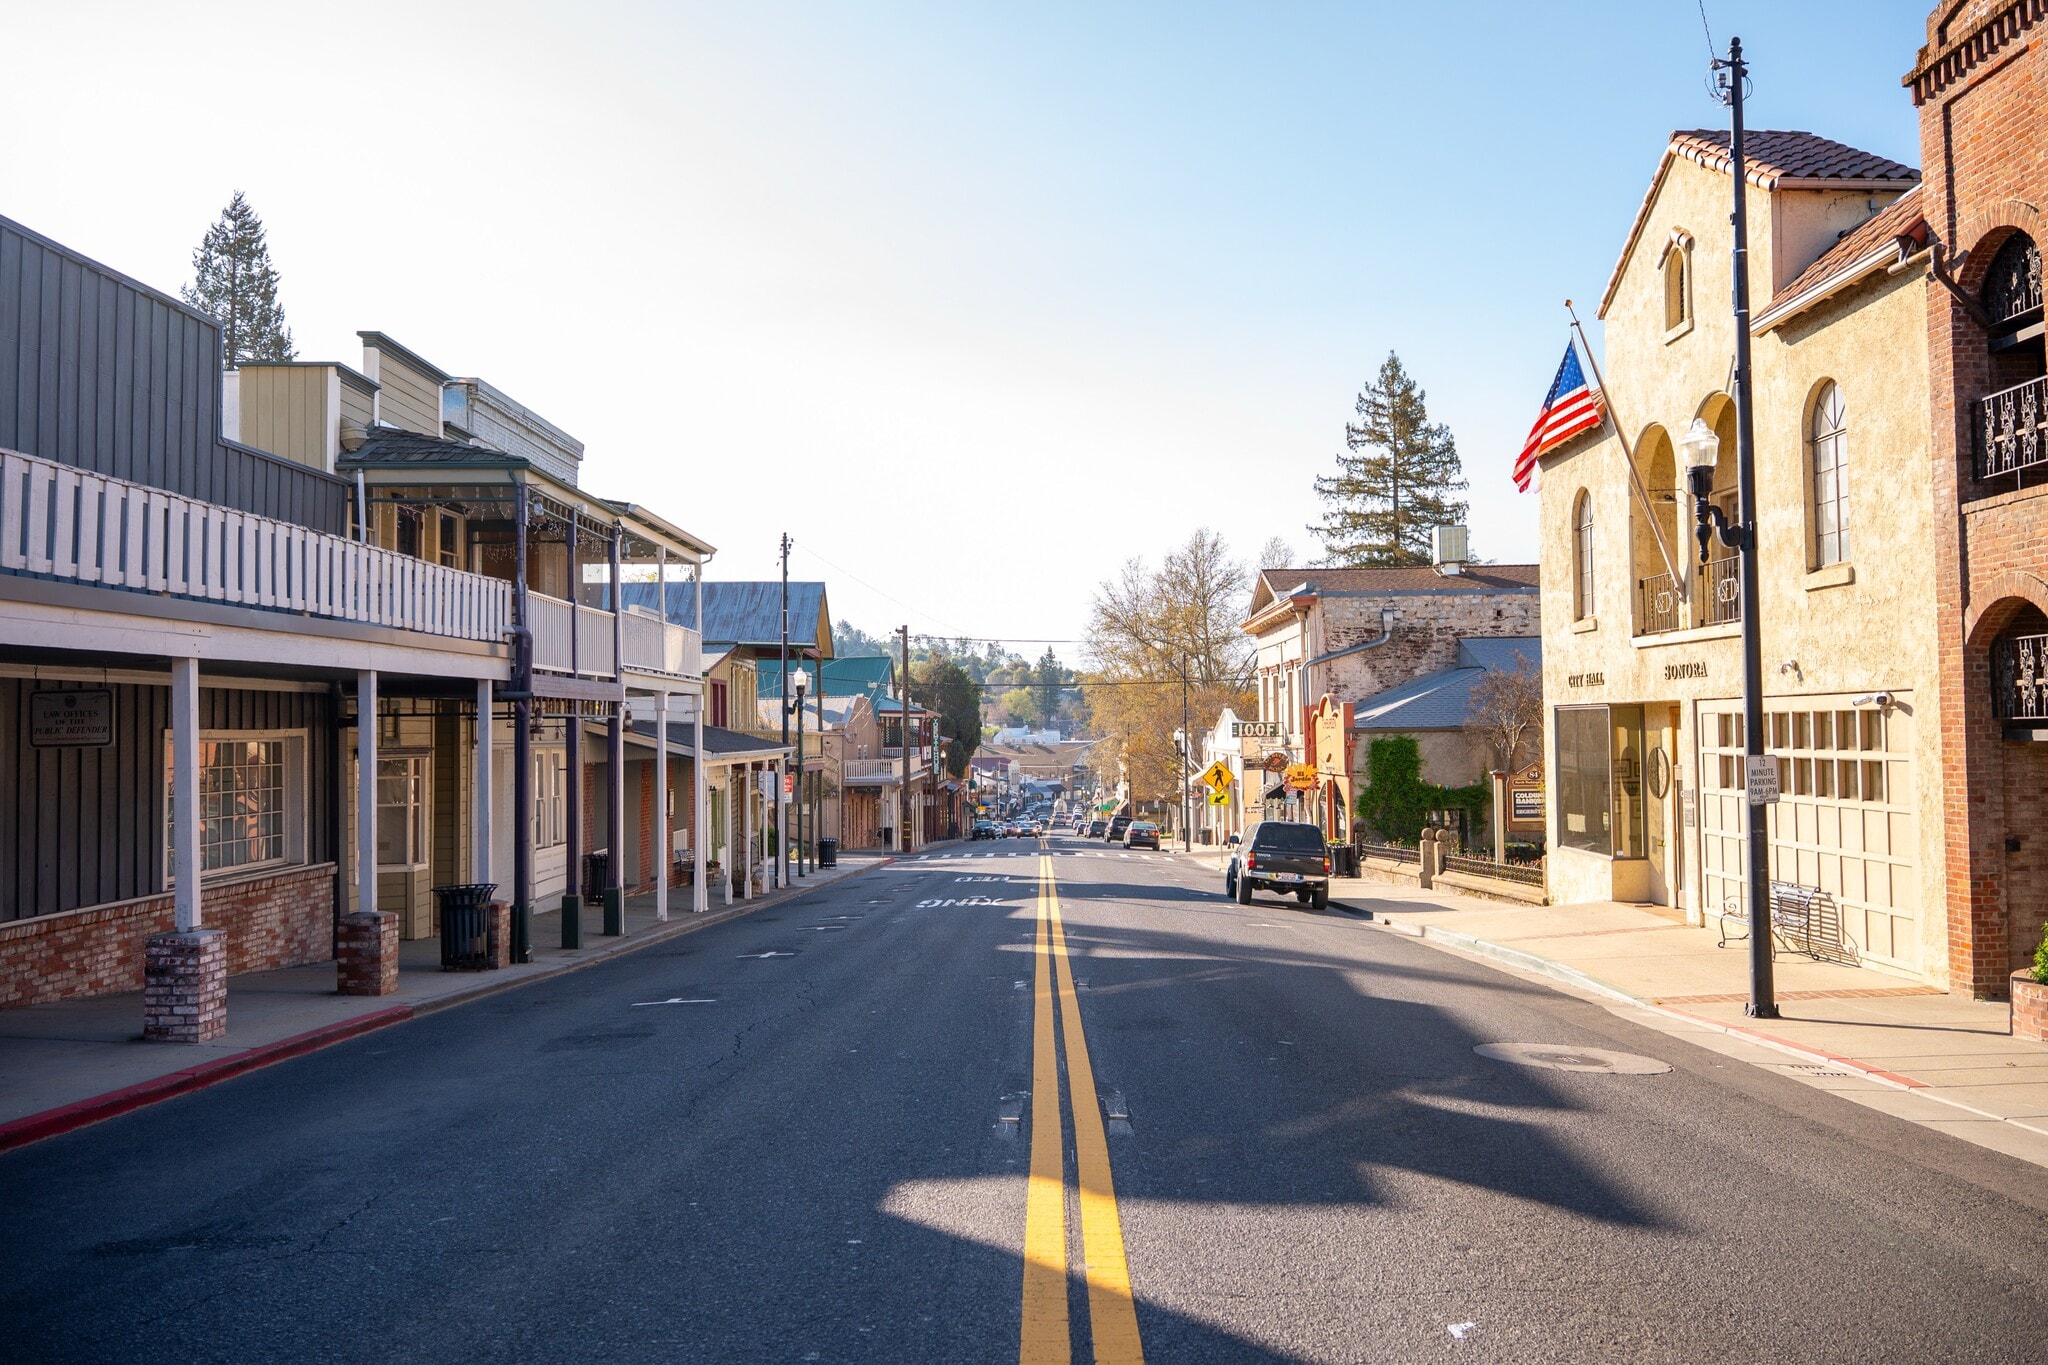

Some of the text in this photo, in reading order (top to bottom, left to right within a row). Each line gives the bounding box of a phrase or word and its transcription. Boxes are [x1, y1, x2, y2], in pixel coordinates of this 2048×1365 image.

[1664, 661, 1708, 680] SONORA
[1568, 672, 1605, 688] CITY HALL
[43, 709, 99, 719] LAW OFFICES
[35, 726, 108, 735] PUBLIC DEFENDER
[1759, 759, 1766, 767] 12
[1751, 768, 1775, 777] MINUTE
[1750, 777, 1777, 786] PARKING
[1750, 787, 1778, 796] 9AM-6PM
